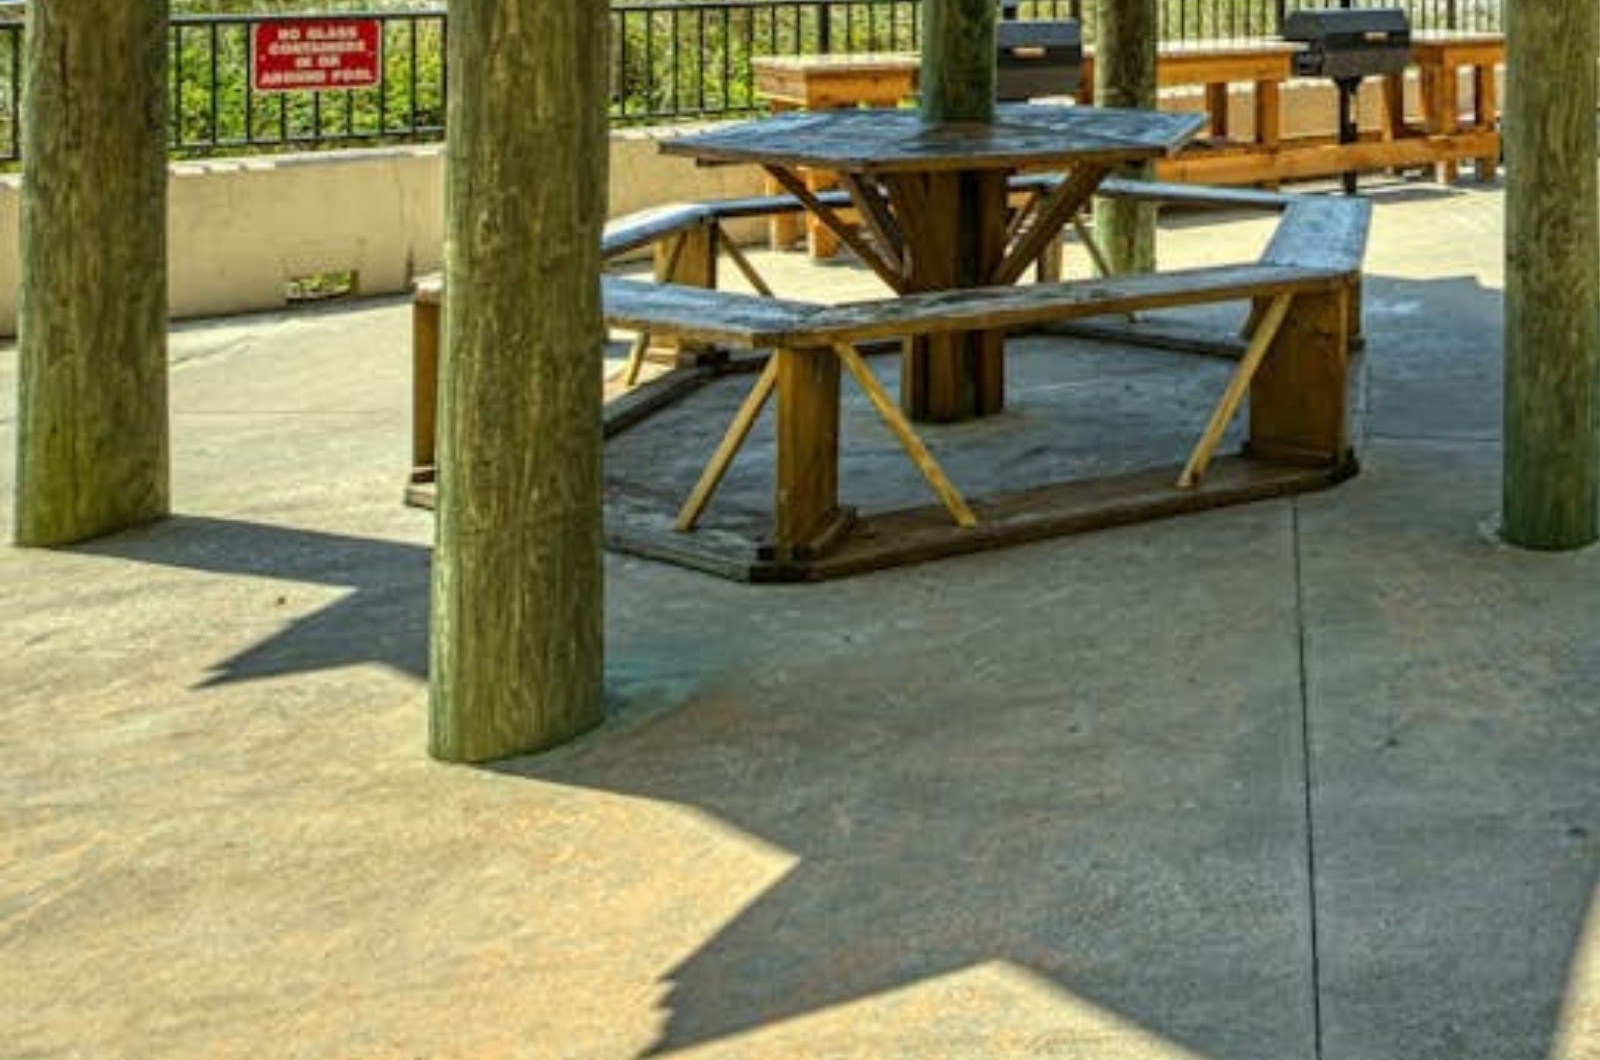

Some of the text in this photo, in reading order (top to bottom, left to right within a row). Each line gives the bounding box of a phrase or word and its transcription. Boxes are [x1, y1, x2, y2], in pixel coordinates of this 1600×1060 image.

[278, 26, 358, 40] NO GLASS
[268, 40, 365, 55] CONTAINERS
[260, 68, 372, 84] AROUND POOL
